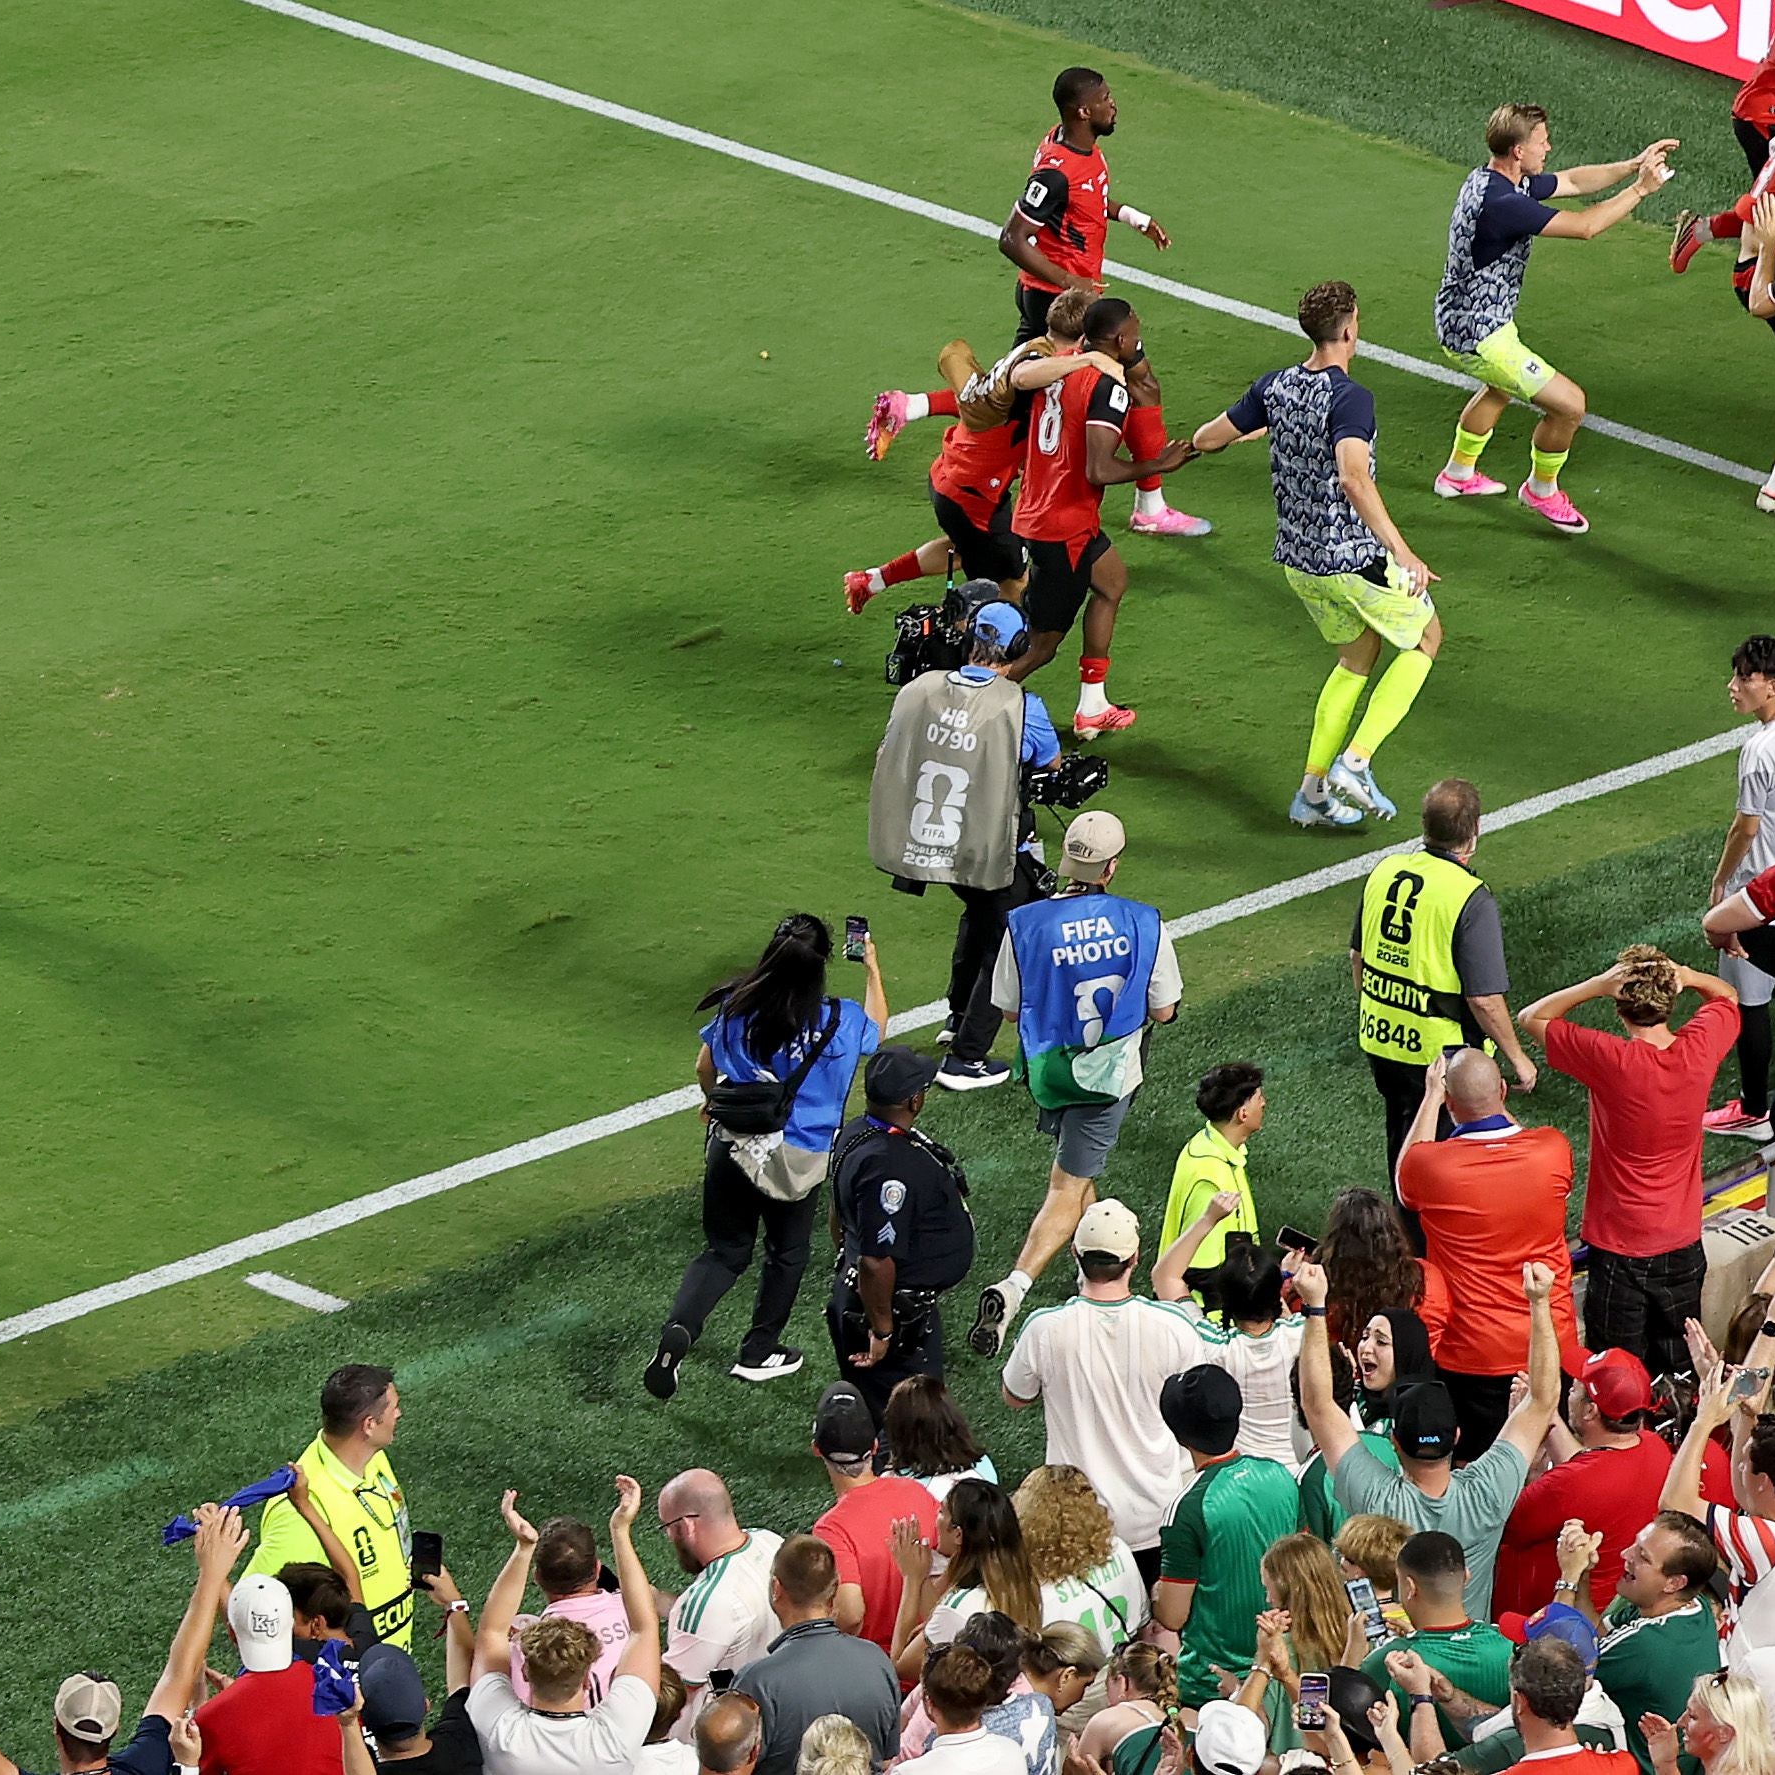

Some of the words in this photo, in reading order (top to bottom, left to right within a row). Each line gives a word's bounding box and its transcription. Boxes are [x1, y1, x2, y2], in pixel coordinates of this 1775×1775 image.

[939, 707, 968, 730] HB
[925, 723, 976, 753] 0790
[921, 827, 946, 840] FIFA
[906, 842, 938, 855] WORLD
[902, 852, 955, 869] 2026
[1061, 915, 1115, 943] FIFA
[1052, 935, 1131, 968] PHOTO
[1377, 949, 1410, 968] 2026
[1721, 1217, 1775, 1246] 116
[1418, 1435, 1441, 1444] USA
[373, 1593, 414, 1638] ECUR
